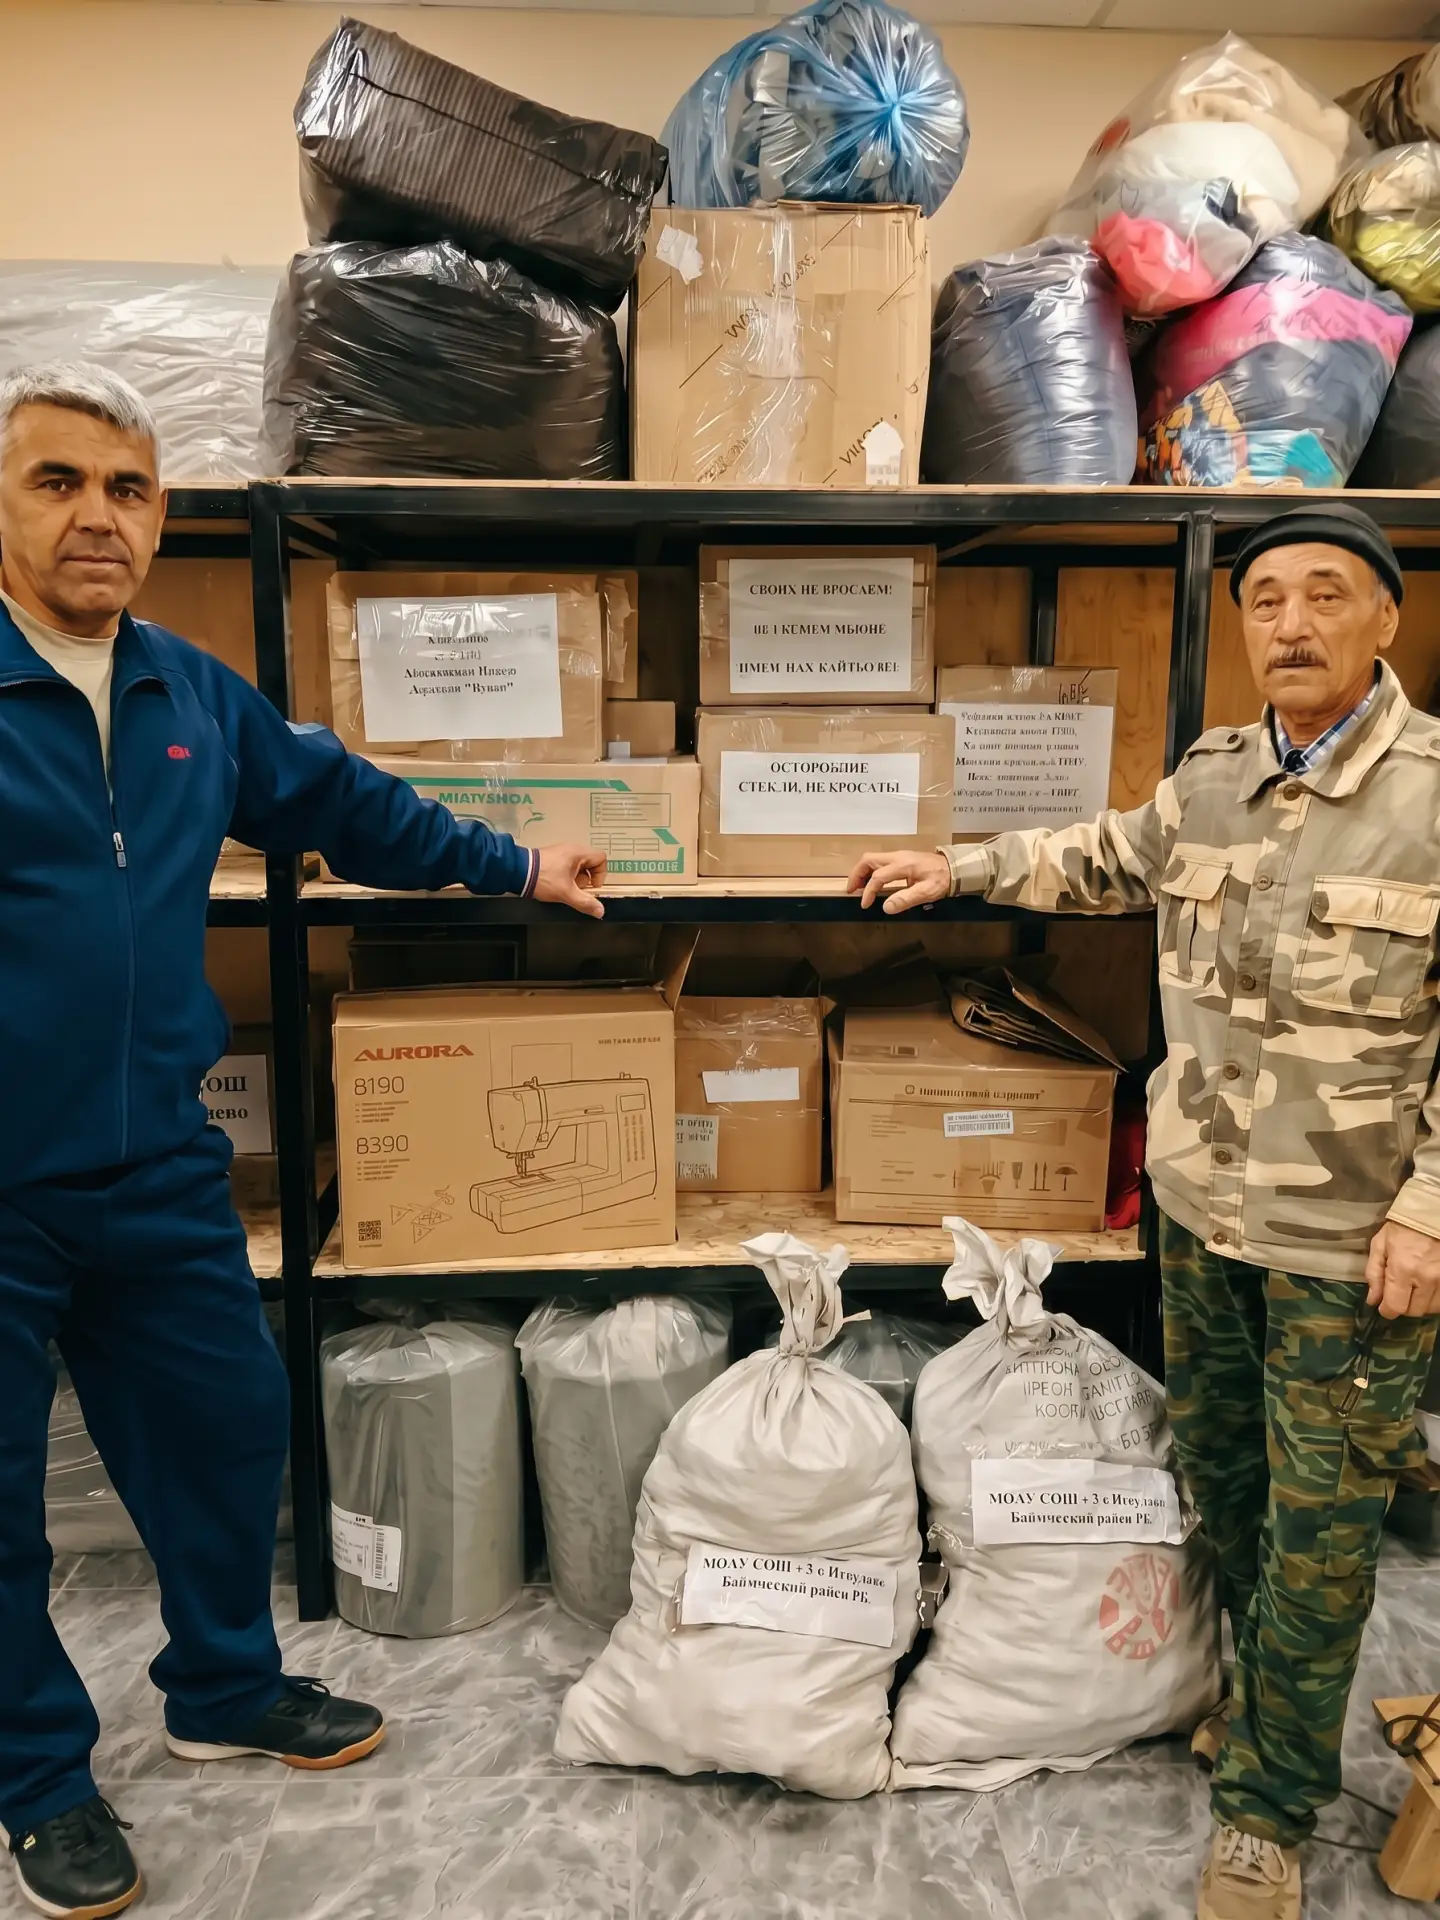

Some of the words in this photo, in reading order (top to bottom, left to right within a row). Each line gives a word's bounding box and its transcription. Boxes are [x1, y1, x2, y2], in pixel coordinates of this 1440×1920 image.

[801, 584, 819, 595] НЕ
[806, 782, 825, 793] НЕ
[354, 1044, 475, 1062] AURORA
[206, 1076, 248, 1093] ОШ
[354, 1076, 405, 1096] 8190
[356, 1135, 409, 1155] 8390
[1040, 1492, 1078, 1505] СОШ
[753, 1557, 791, 1573] СОШ
